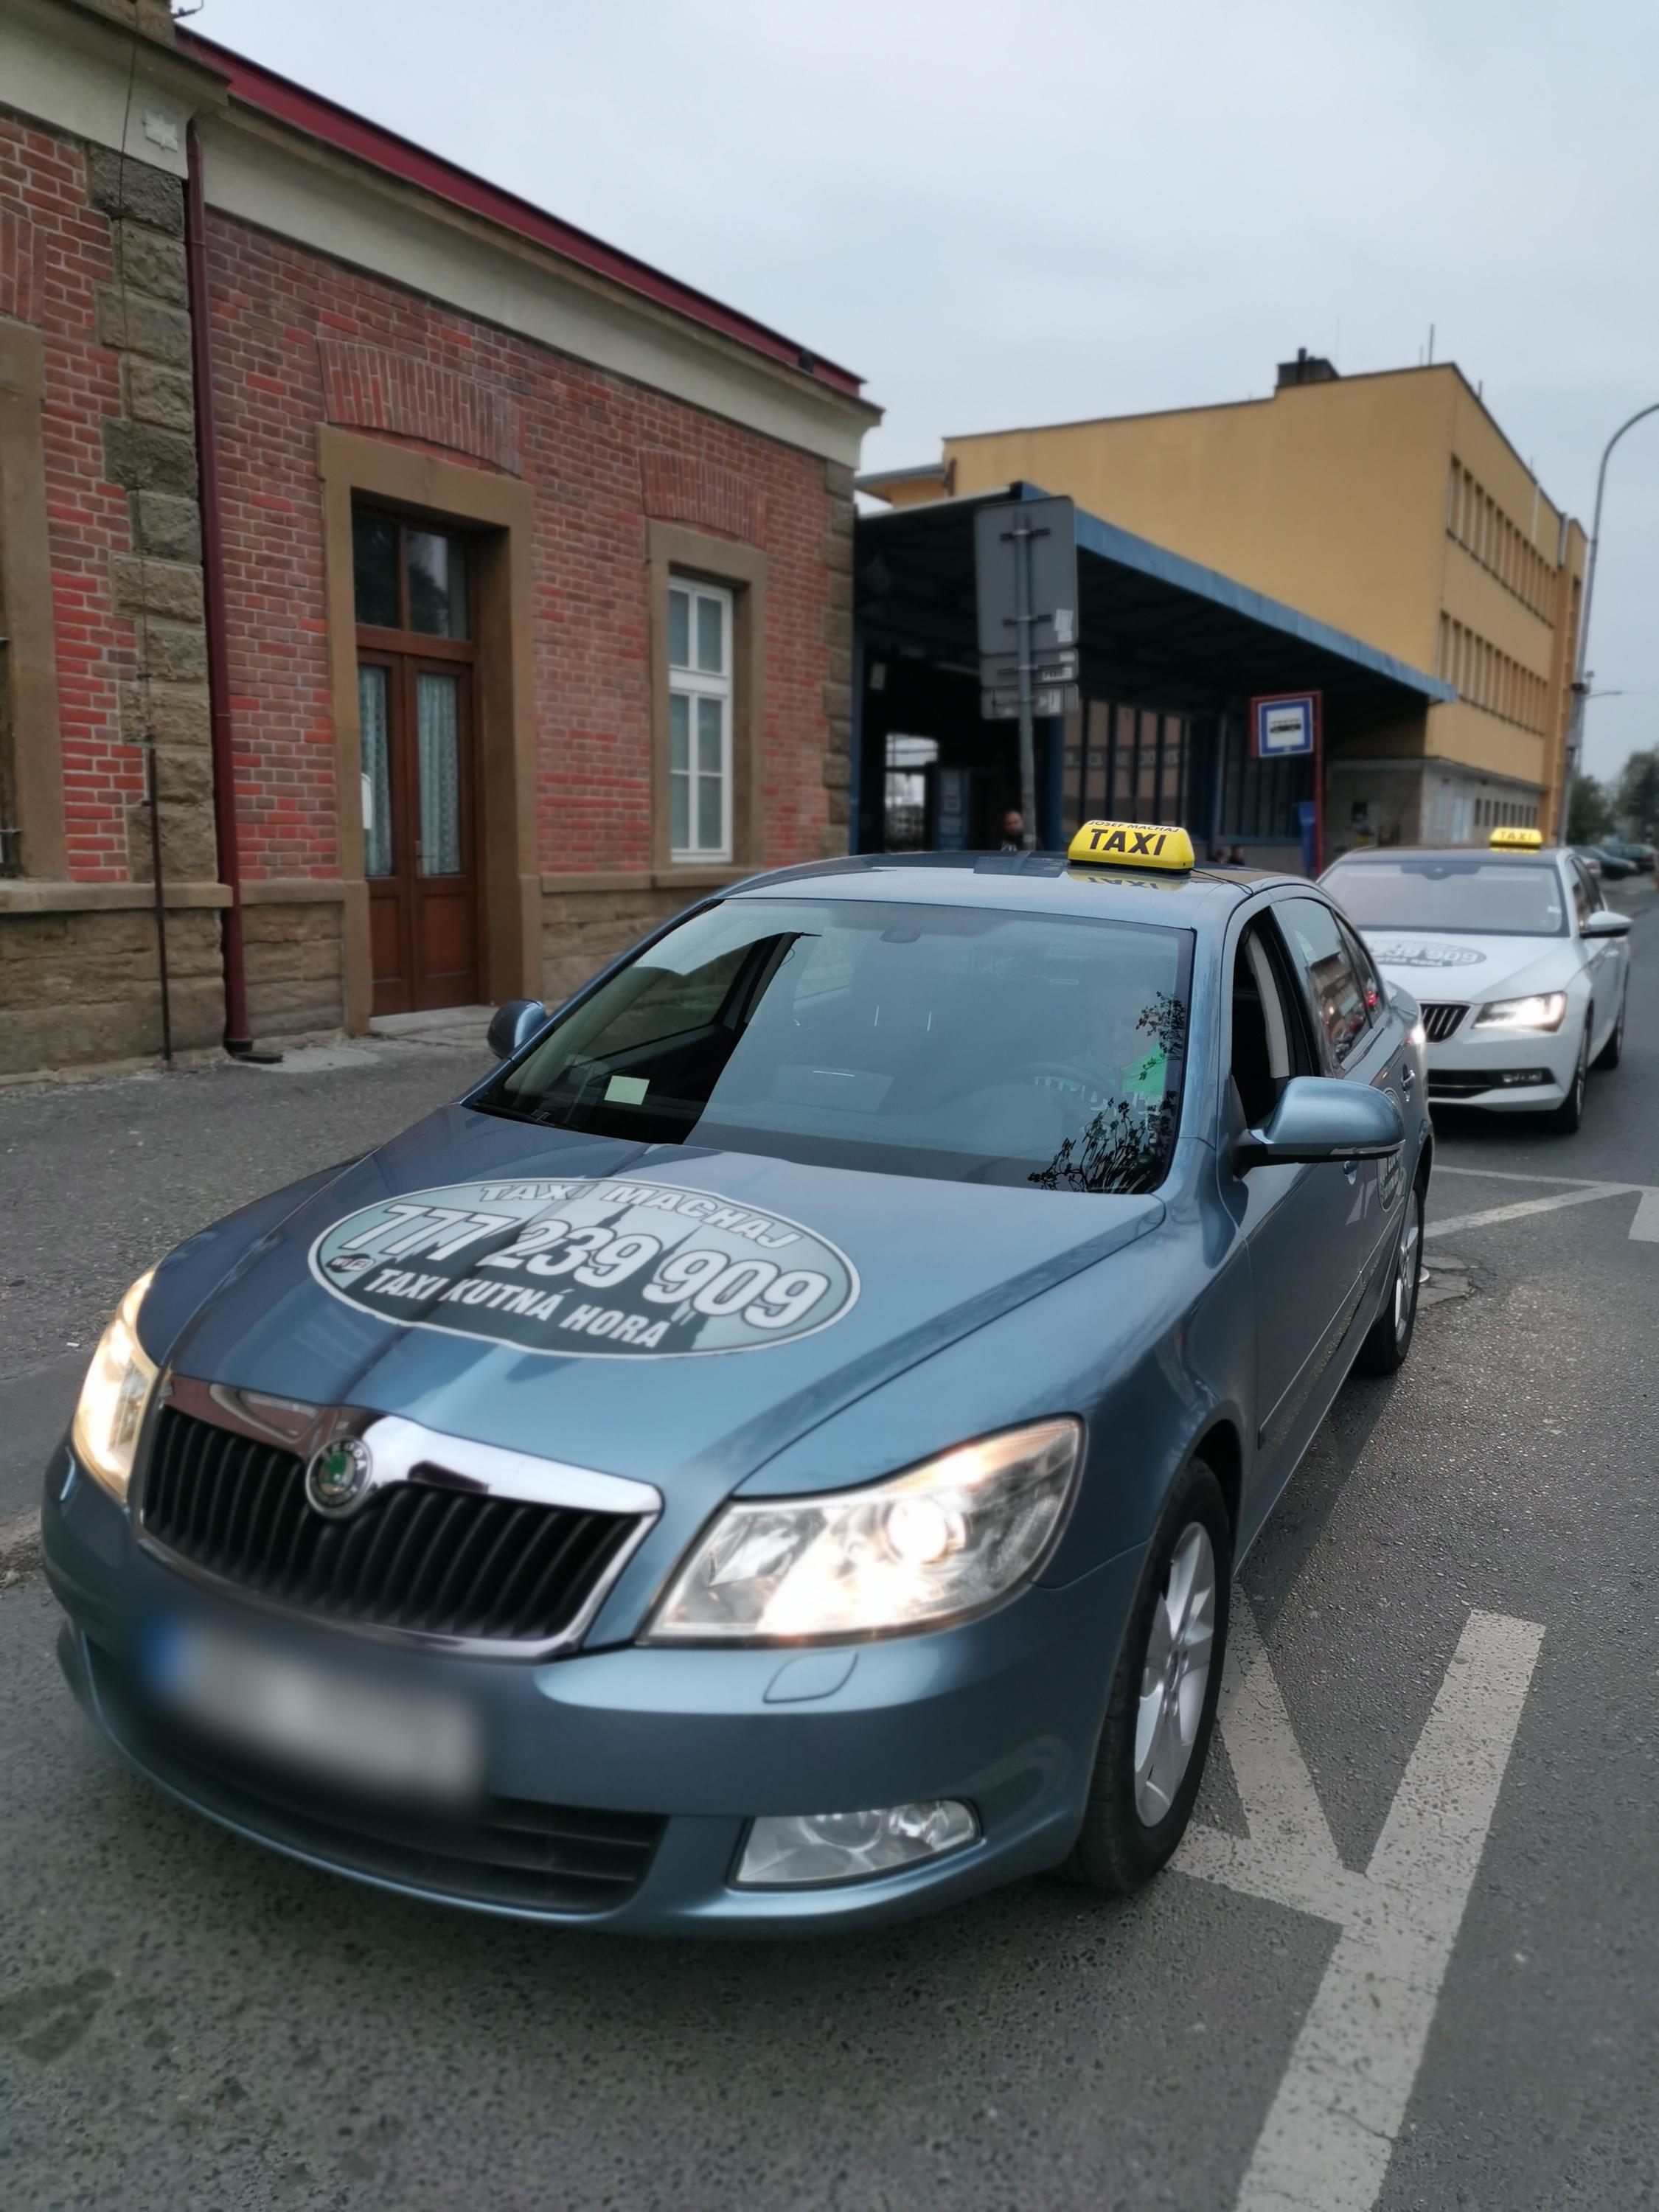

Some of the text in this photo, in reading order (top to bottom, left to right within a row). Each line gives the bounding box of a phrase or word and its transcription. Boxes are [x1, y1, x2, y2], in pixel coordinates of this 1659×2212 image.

[1127, 823, 1180, 832] MACHAJ
[1500, 831, 1533, 841] TAXI
[1090, 828, 1166, 856] TAXI
[1426, 950, 1478, 962] 909
[479, 1183, 804, 1249] TAXI MACHAJ
[337, 1203, 831, 1329] 777 239 909
[364, 1268, 671, 1348] TAXI KUTNÁ HORA
